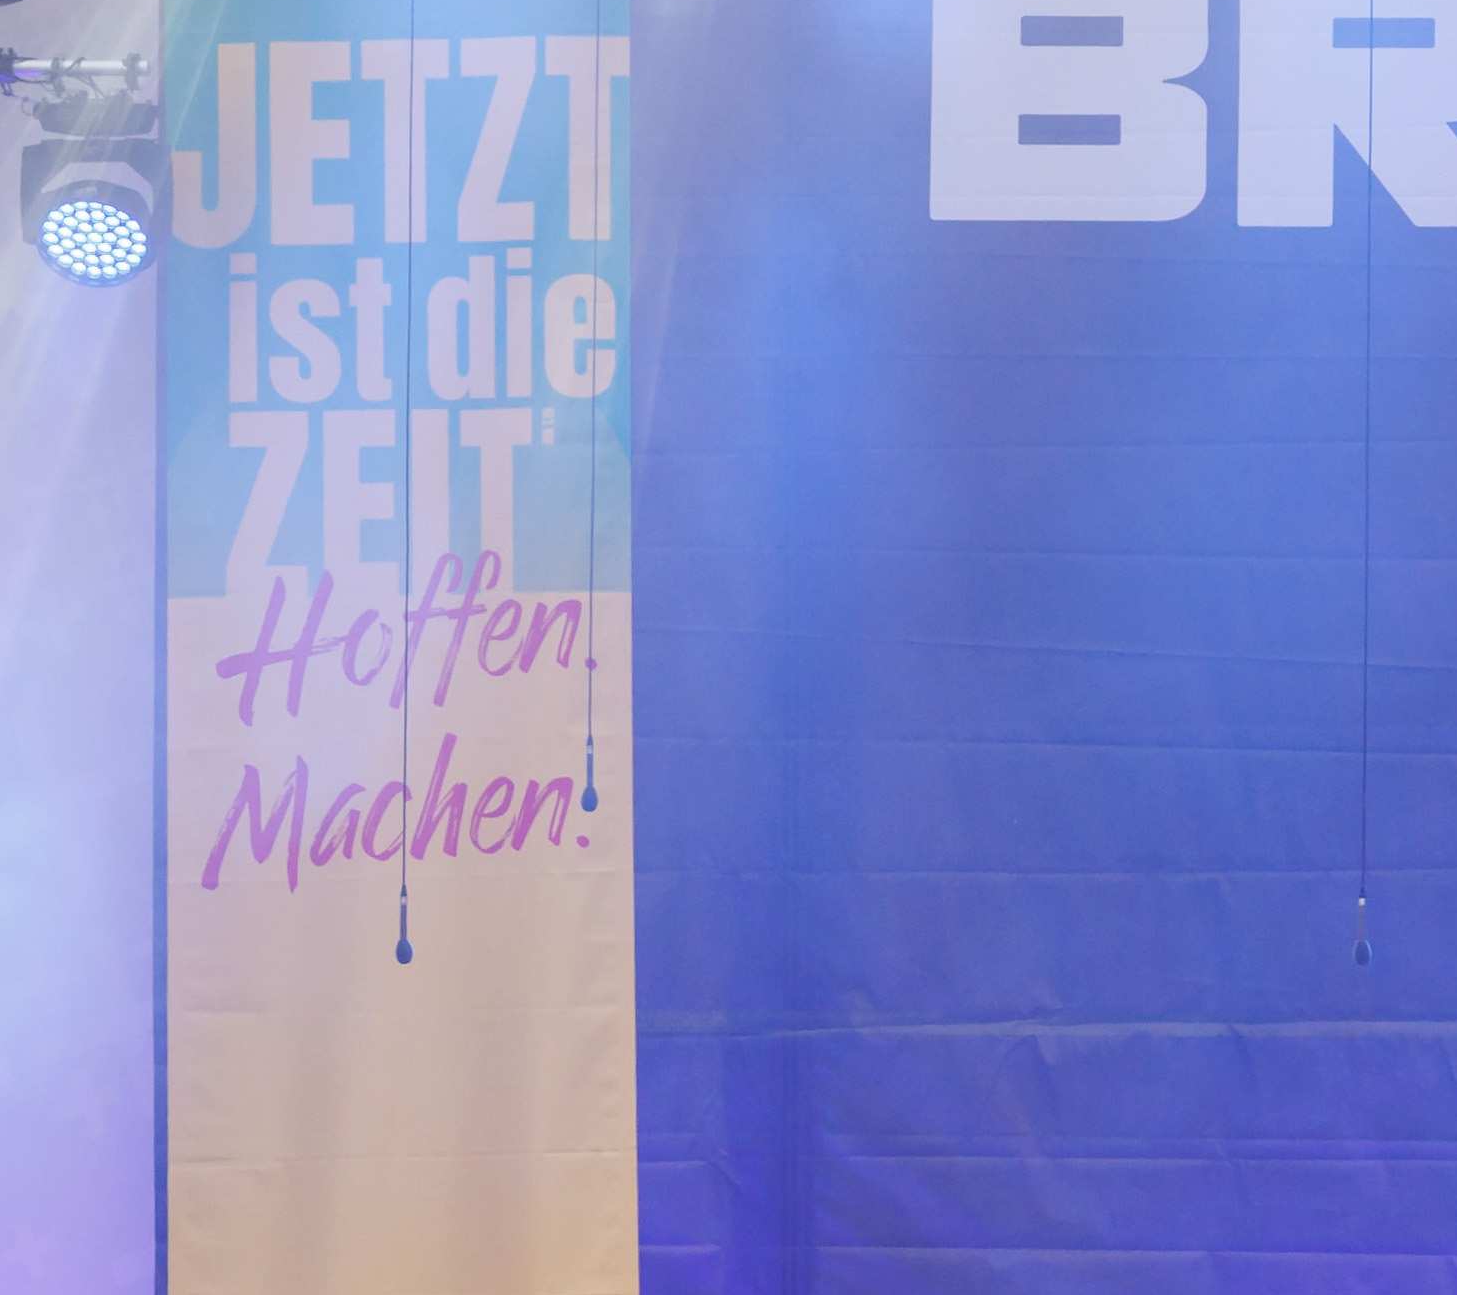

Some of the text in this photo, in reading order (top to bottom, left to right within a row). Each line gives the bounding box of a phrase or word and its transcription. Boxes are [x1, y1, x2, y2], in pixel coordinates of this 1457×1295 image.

[173, 35, 630, 249] JETZT
[229, 247, 616, 404] ist die
[227, 408, 532, 597] ZEIT
[216, 550, 598, 727] Hoffen.
[201, 733, 591, 893] Machen.
